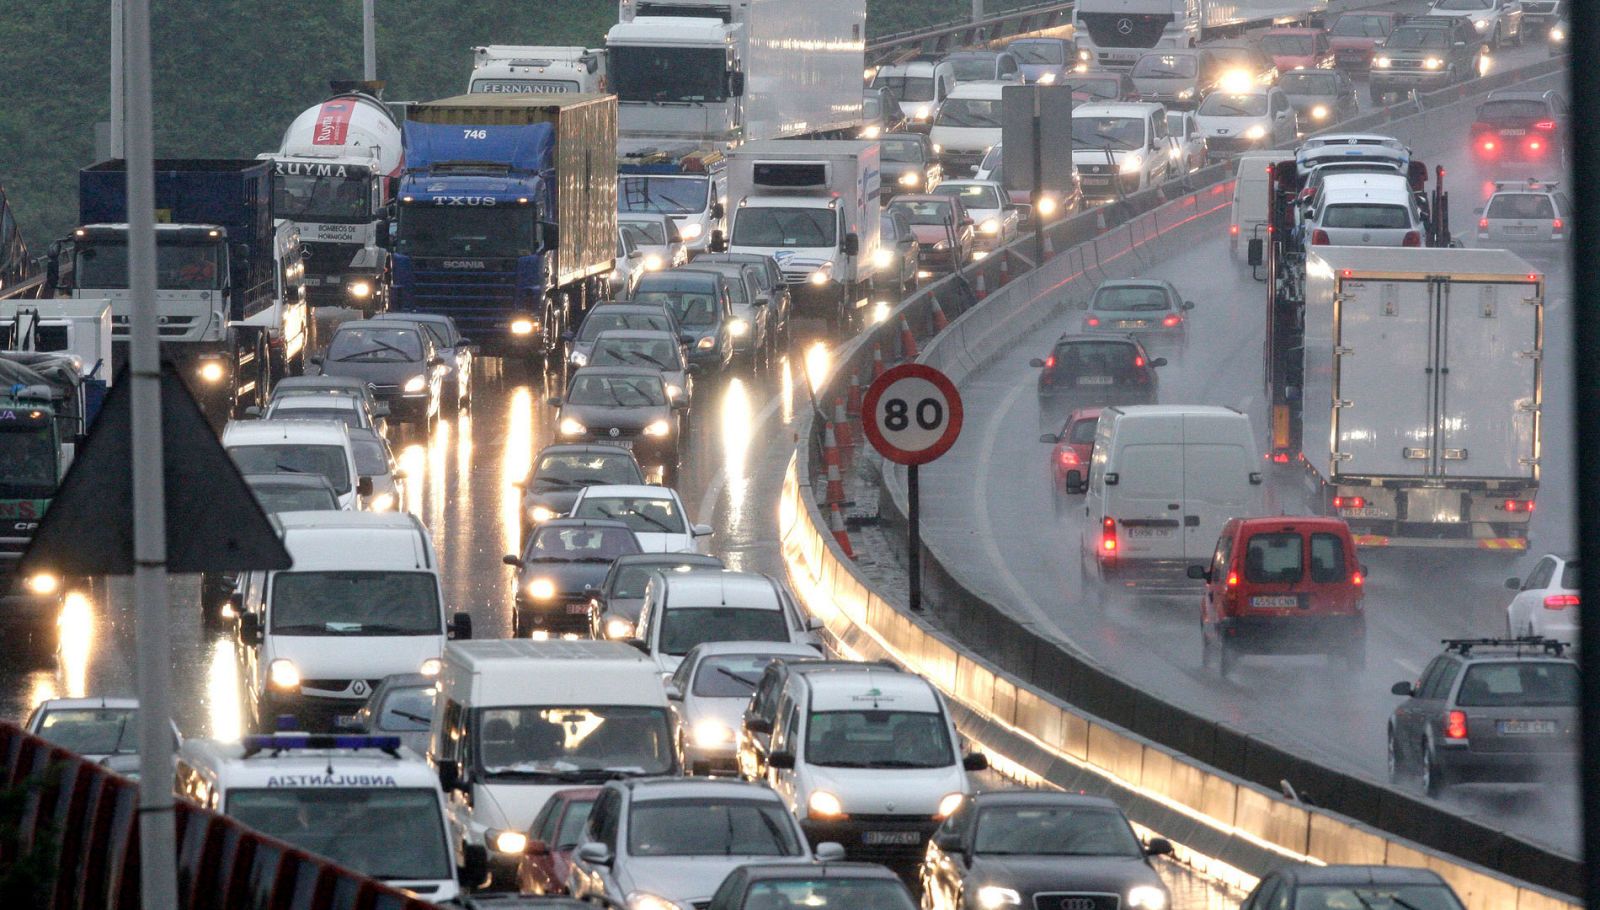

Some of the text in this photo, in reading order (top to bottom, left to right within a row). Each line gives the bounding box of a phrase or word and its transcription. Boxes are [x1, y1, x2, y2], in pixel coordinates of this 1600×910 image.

[482, 83, 568, 94] FERNANDO
[463, 129, 486, 140] 746
[274, 162, 348, 178] RUYMA
[432, 196, 496, 206] TXUS
[443, 260, 485, 269] SCANIA
[884, 398, 943, 431] 80
